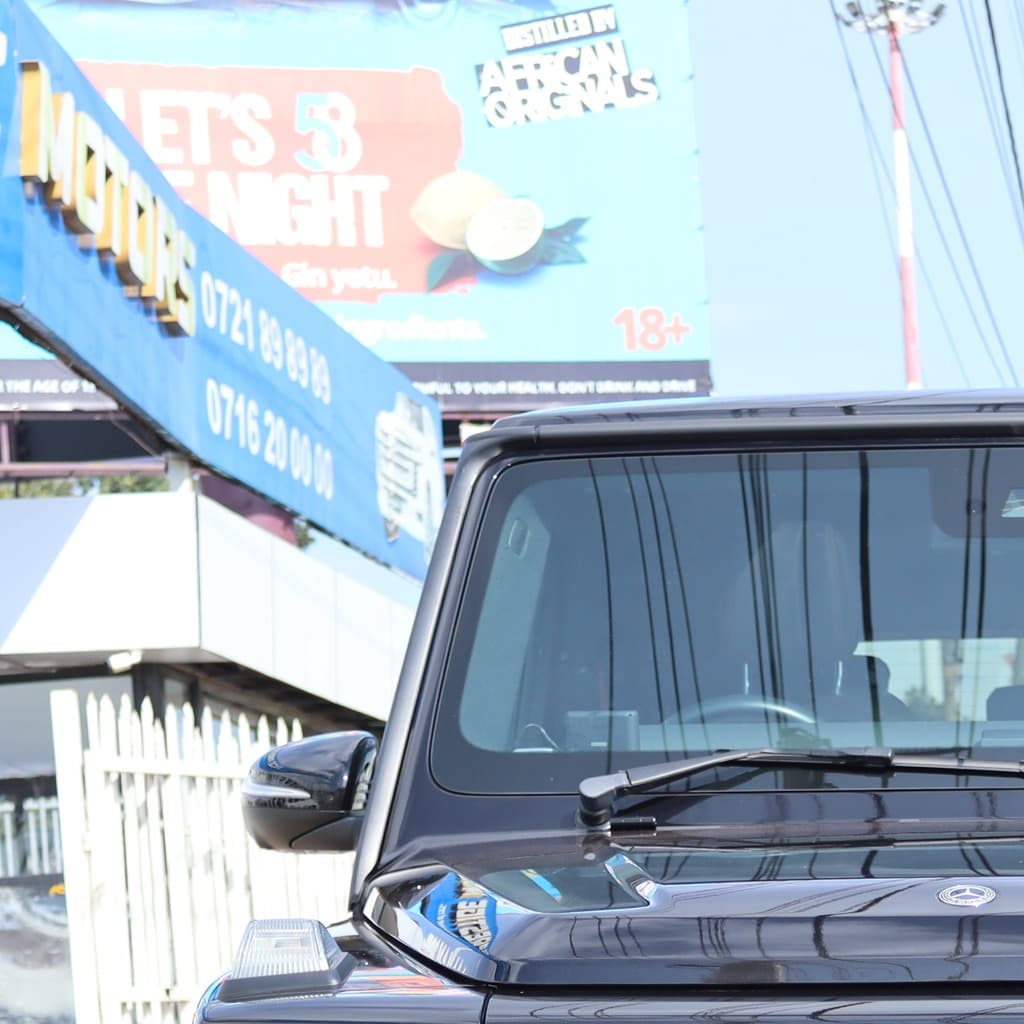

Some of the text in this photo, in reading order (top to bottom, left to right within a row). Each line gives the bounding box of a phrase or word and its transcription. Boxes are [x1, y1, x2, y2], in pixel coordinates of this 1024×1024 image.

[20, 61, 196, 337] MOTORS
[206, 171, 390, 248] NIGHT
[201, 271, 332, 405] 0721 89 89 89
[612, 307, 692, 352] 18+
[206, 378, 334, 500] 0716 20 00 00
